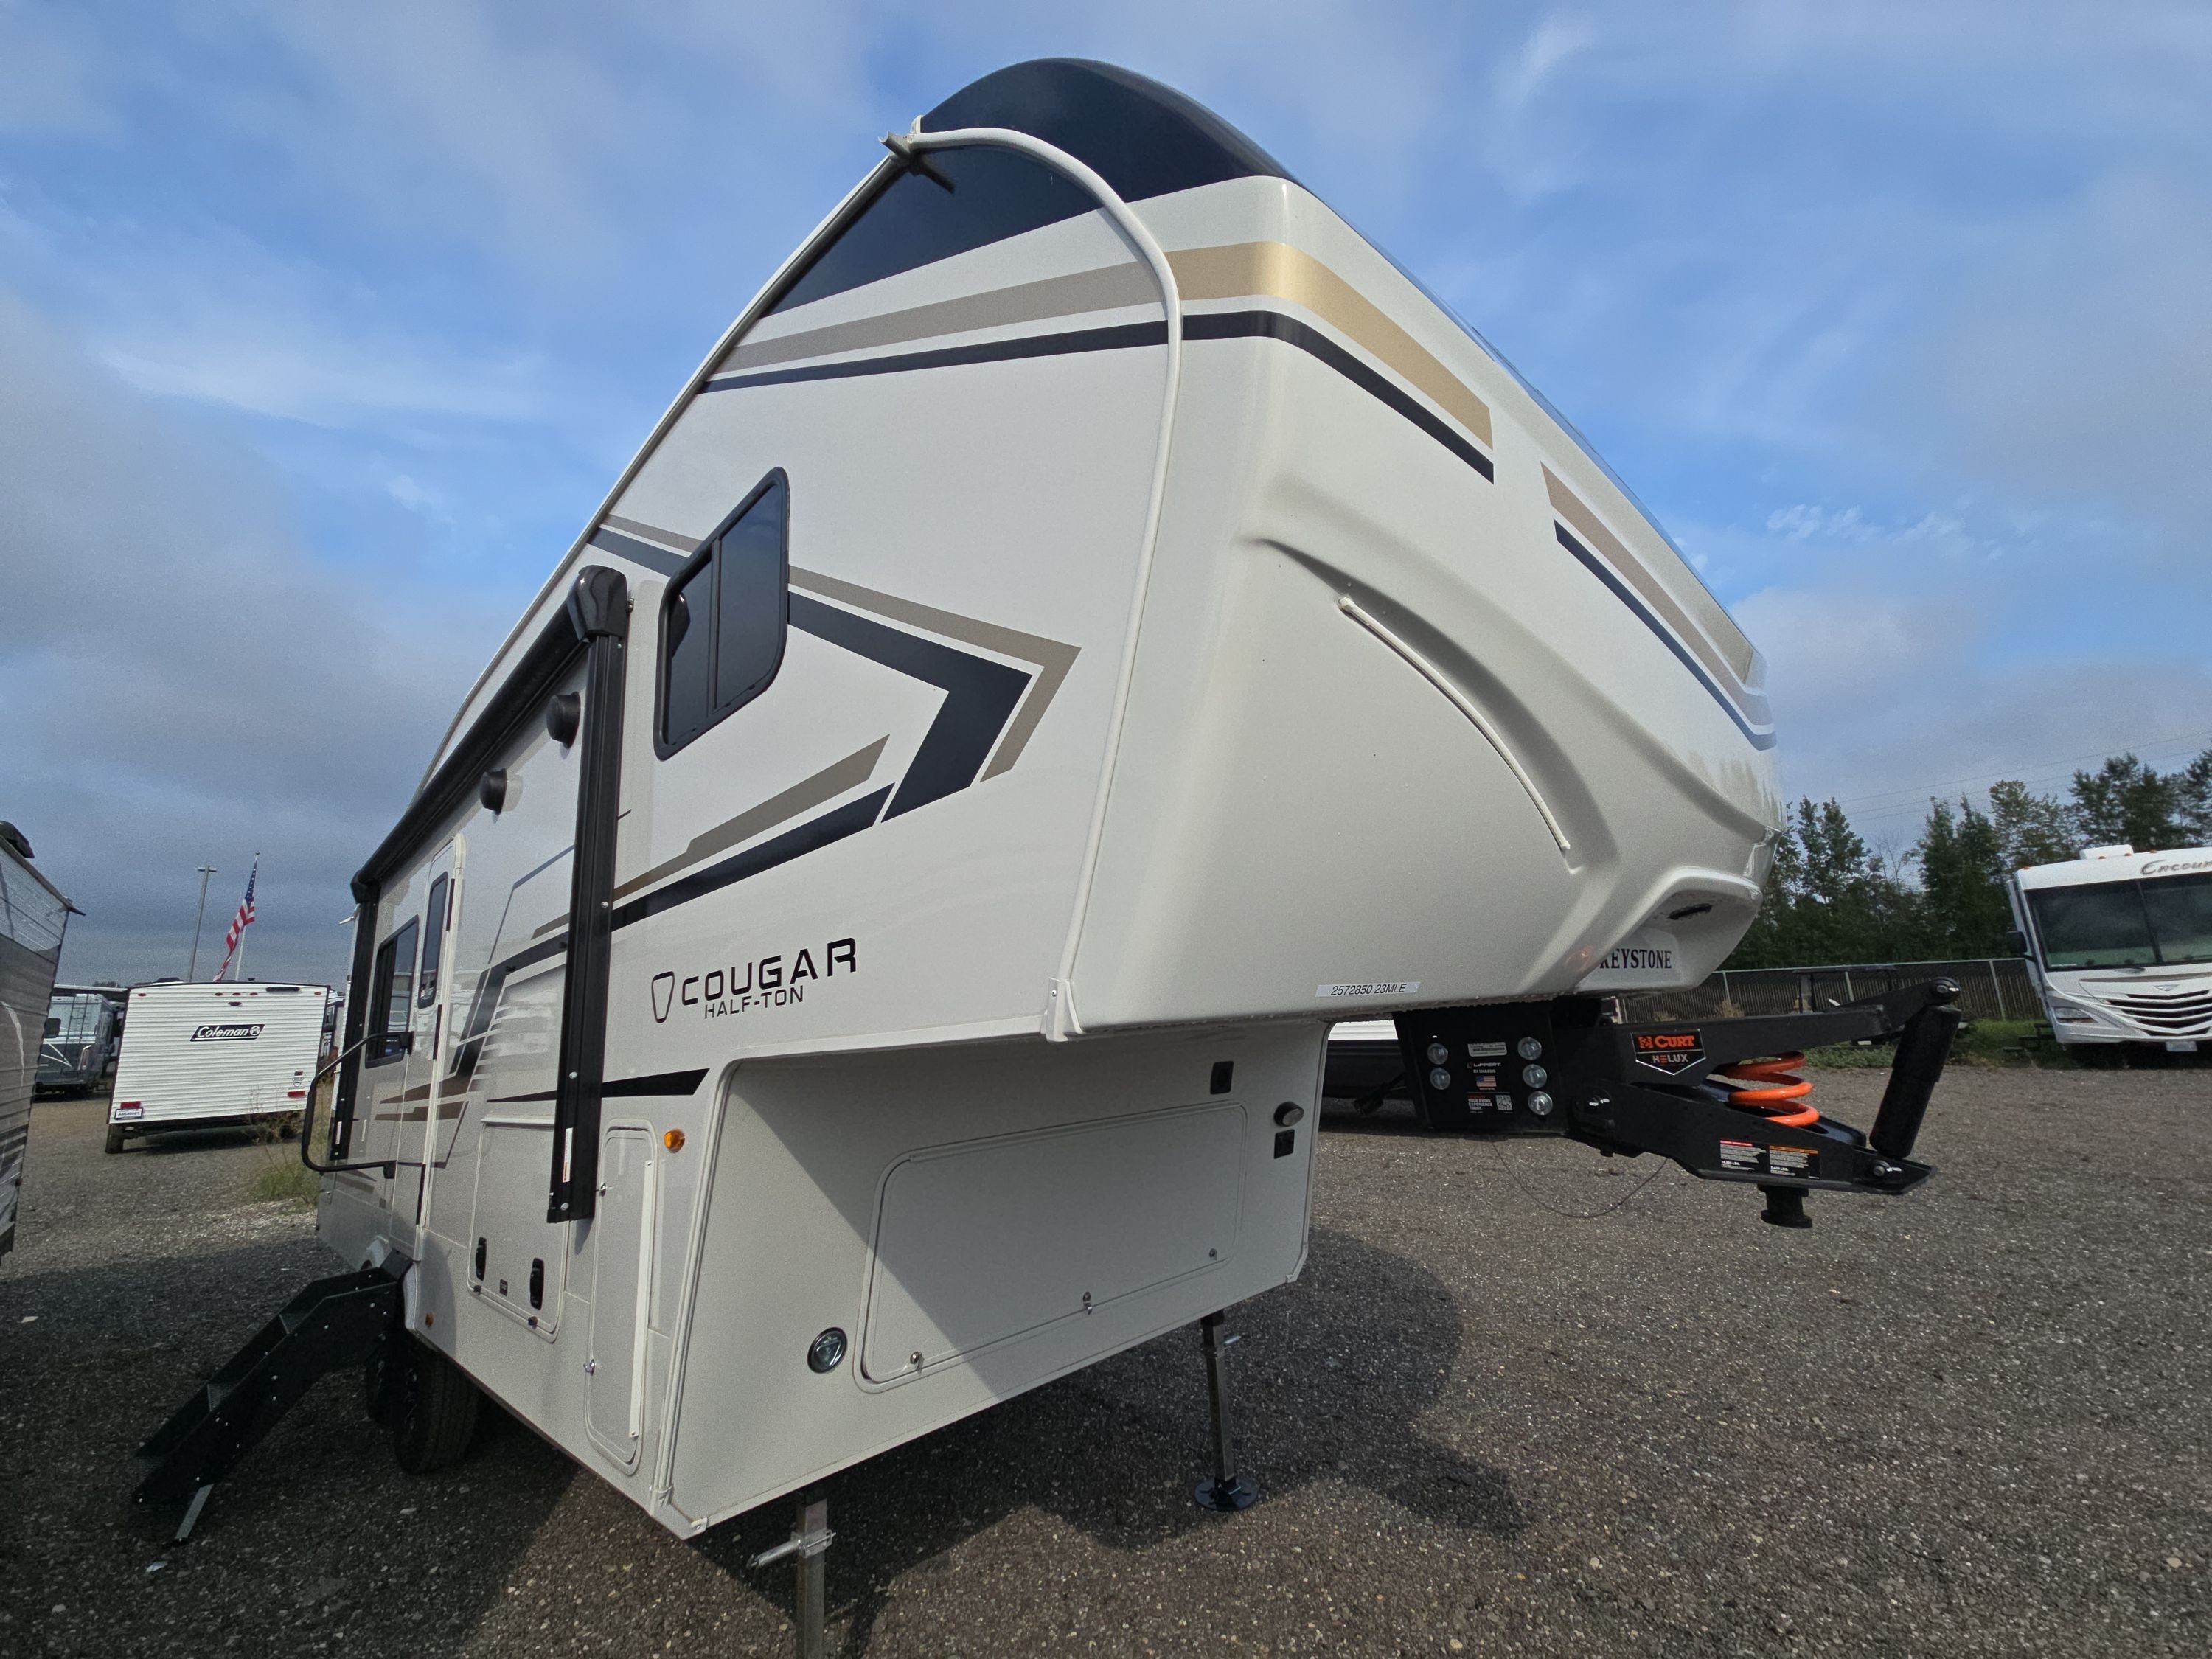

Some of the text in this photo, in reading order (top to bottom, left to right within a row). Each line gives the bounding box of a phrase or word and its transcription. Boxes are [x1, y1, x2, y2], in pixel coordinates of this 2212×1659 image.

[681, 937, 857, 1006] COUGAR
[1330, 983, 1407, 995] 2572850 23MLE
[704, 985, 804, 1019] HALF-TON
[197, 1026, 249, 1038] Coleman
[1655, 1035, 1695, 1048] CURT
[1652, 1054, 1688, 1063] HELUX
